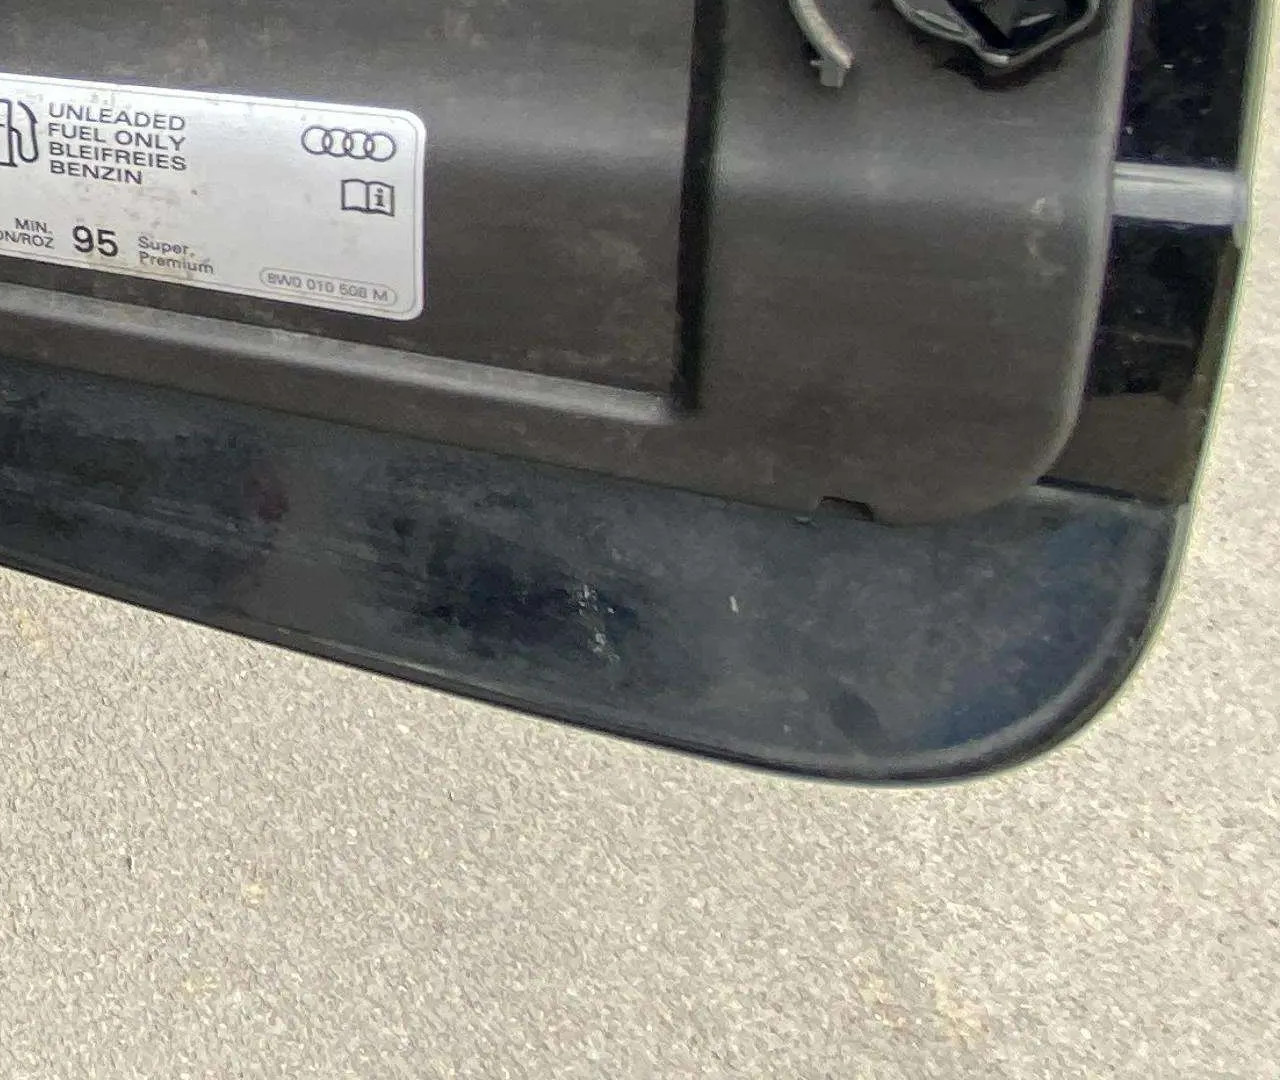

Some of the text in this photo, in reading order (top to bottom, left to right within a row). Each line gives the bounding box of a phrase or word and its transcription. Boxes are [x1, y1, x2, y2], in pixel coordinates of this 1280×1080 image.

[48, 102, 186, 131] UNLEADED
[48, 122, 186, 151] FUEL ONLY
[48, 141, 187, 171] BLEIFREIES
[49, 159, 142, 185] BENZIN
[14, 217, 52, 234] MIN.
[72, 224, 119, 258] 95
[138, 251, 214, 274] Premium
[306, 278, 334, 293] 010
[339, 281, 368, 299] 508
[372, 289, 389, 302] M
